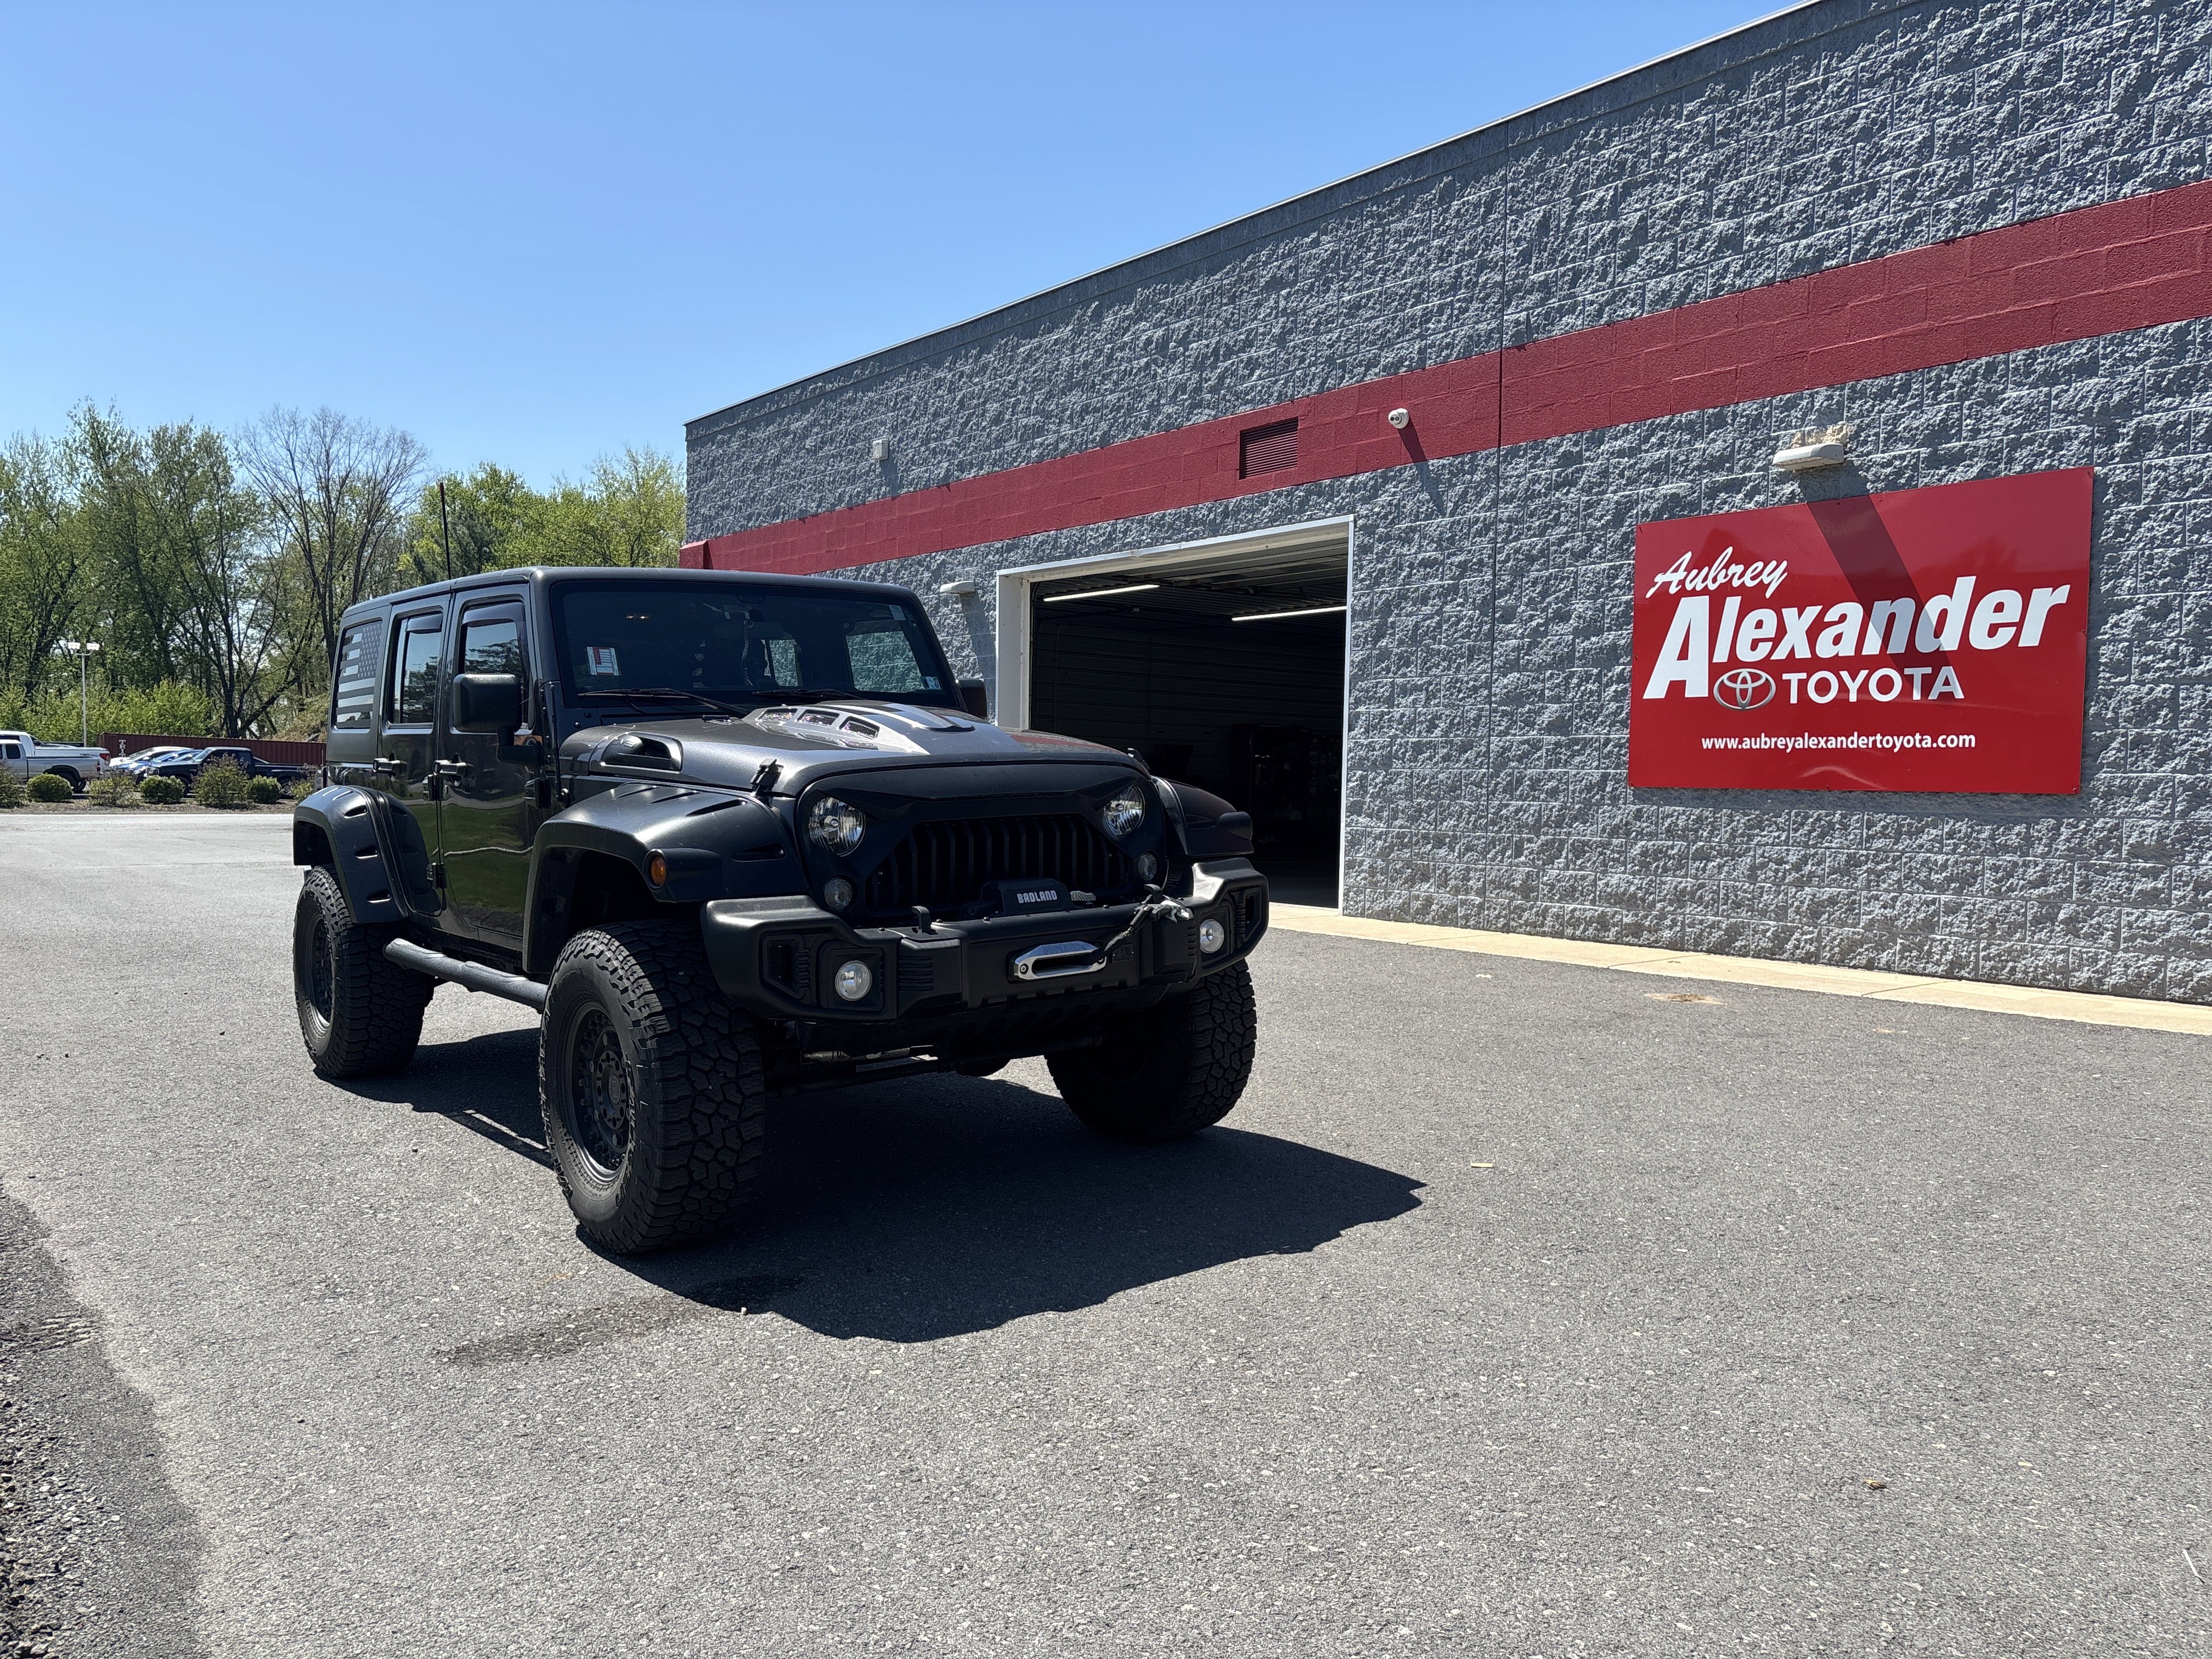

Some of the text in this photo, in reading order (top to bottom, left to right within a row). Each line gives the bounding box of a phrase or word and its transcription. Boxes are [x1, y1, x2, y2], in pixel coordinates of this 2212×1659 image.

[1646, 546, 1788, 600] Aubrey
[1643, 576, 2071, 699] Alexander
[1782, 665, 1965, 704] TOYOTA
[1701, 731, 1976, 753] www.aubreyalexandertoyota.com
[1017, 890, 1058, 904] BADLAND
